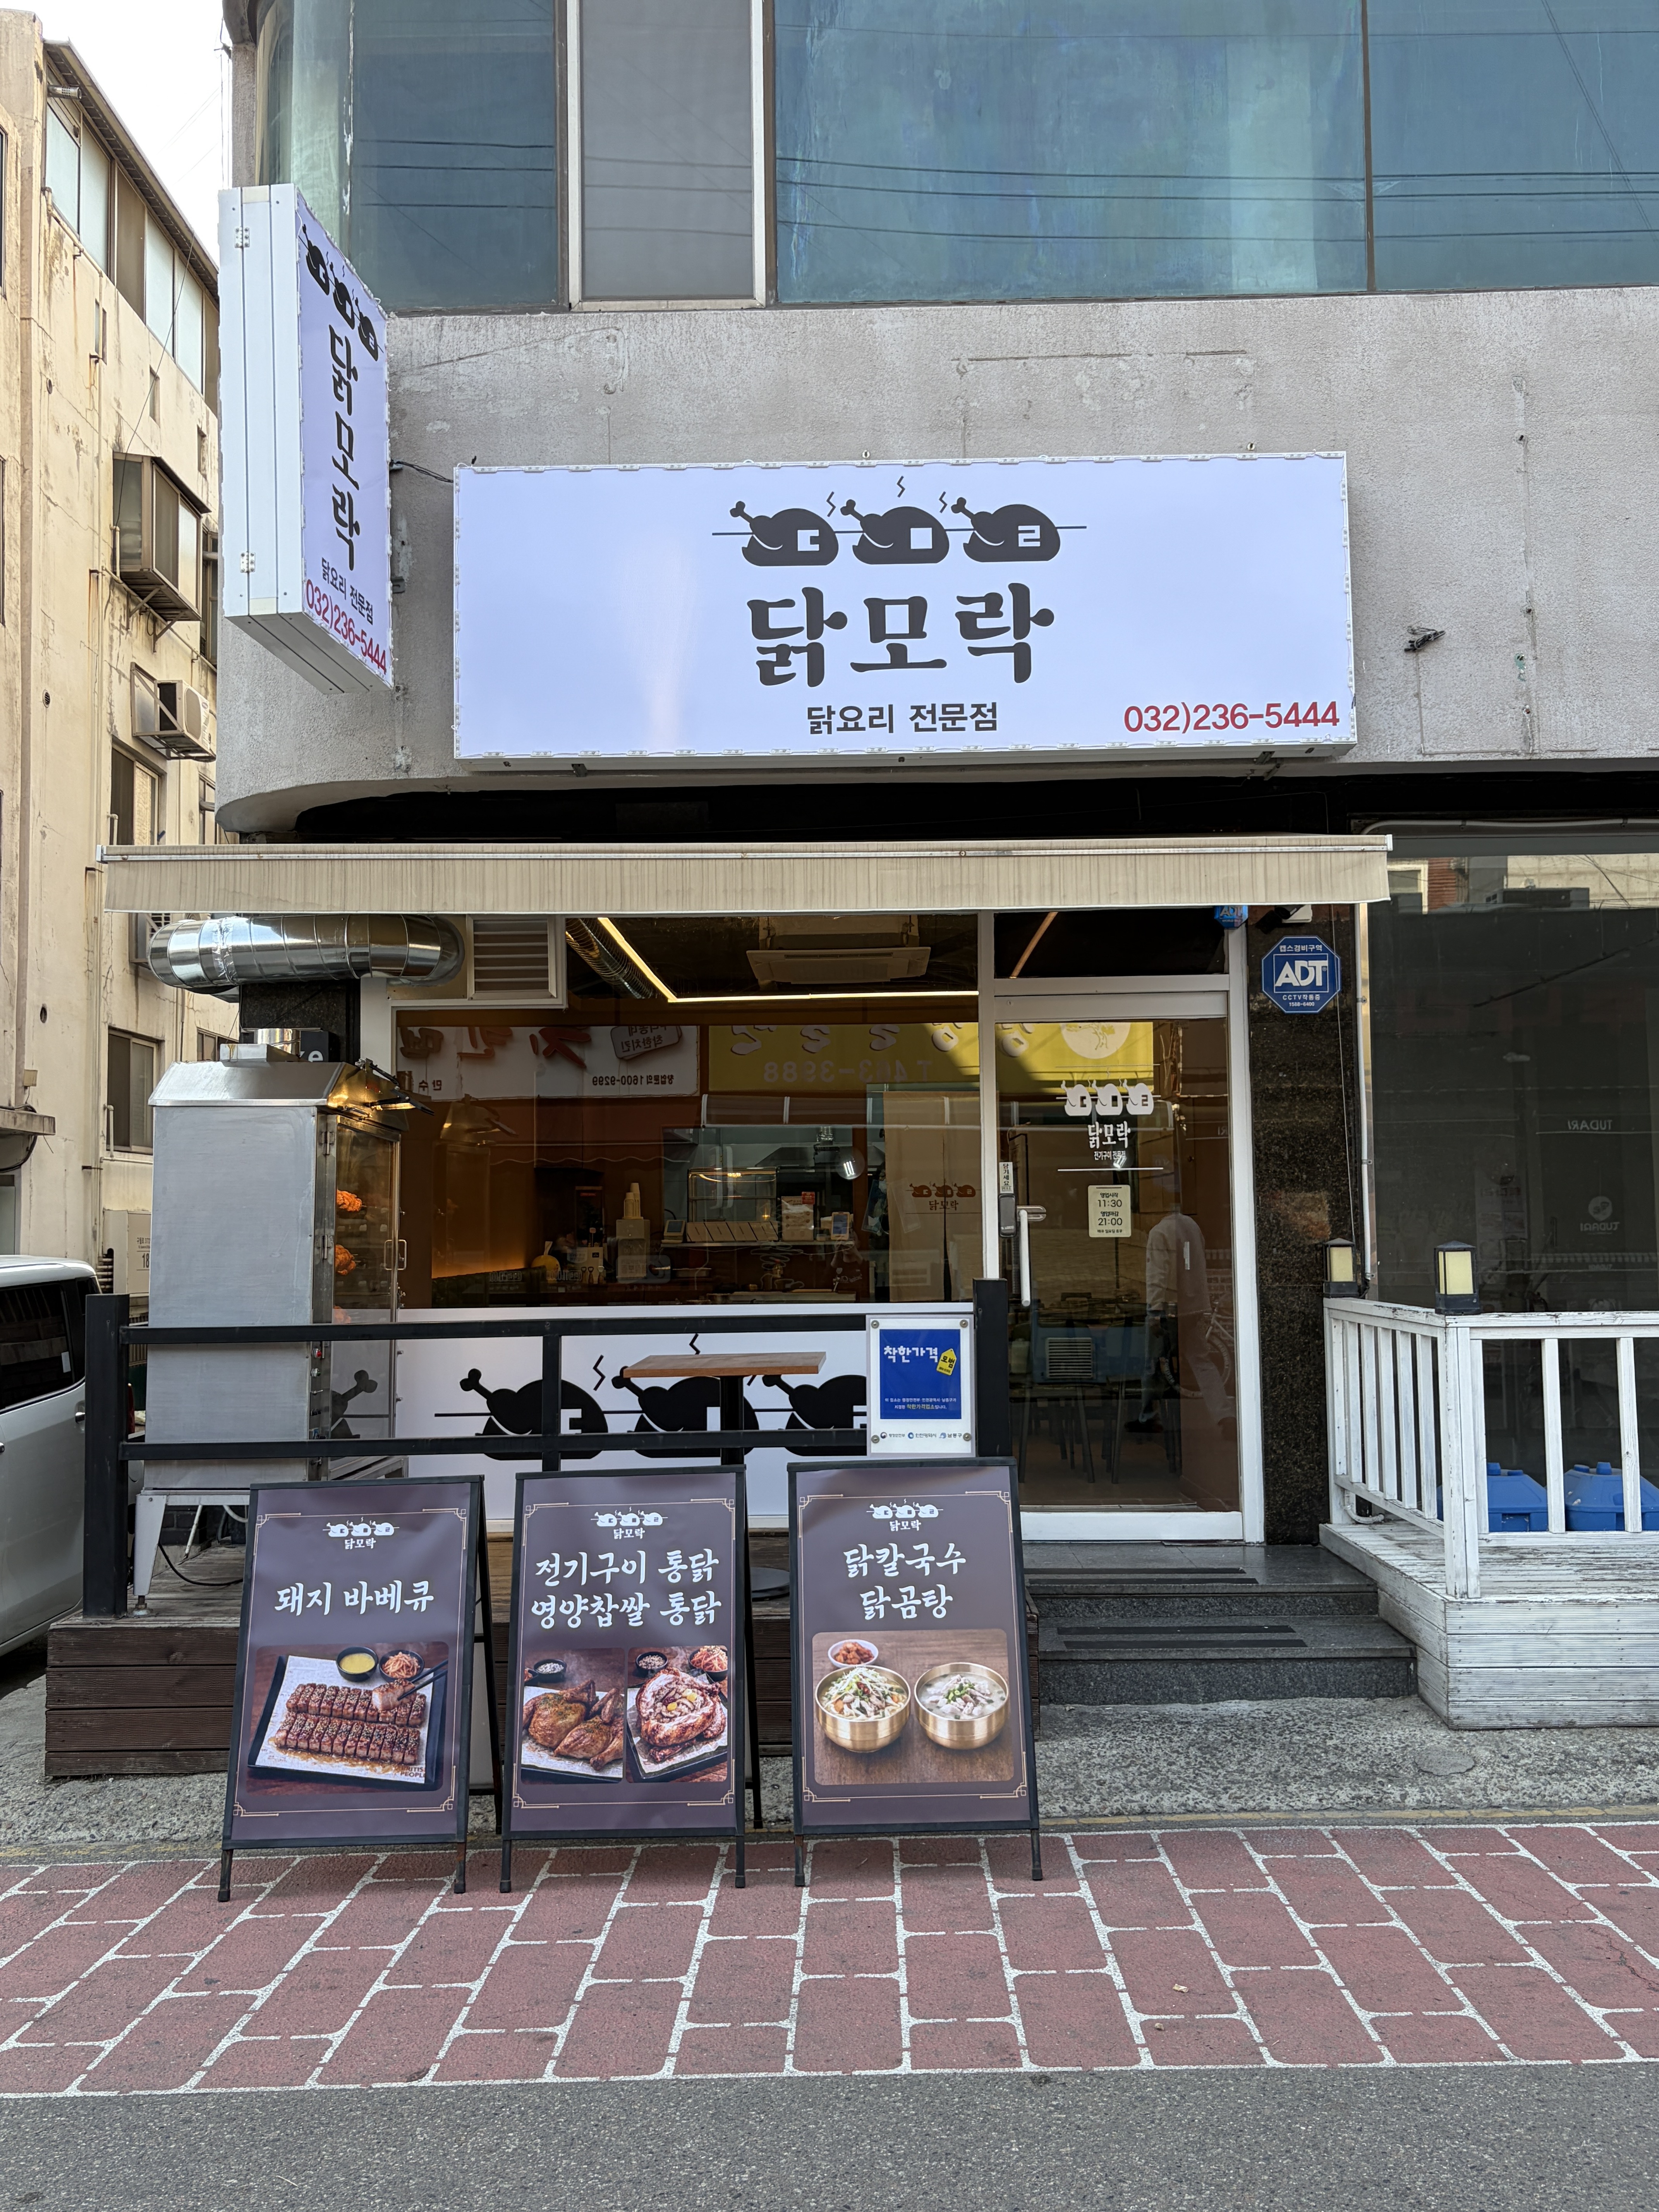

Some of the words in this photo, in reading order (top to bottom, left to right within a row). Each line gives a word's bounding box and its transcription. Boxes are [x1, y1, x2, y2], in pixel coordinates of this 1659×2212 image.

[321, 557, 347, 601] 닭요리
[349, 584, 375, 627] 전문점
[305, 579, 388, 674] 032)236-5444
[747, 583, 1054, 687] 닭모락
[807, 704, 894, 735] 닭요리
[909, 702, 998, 733] 전문점
[1124, 701, 1340, 734] 032)236-5444
[1275, 960, 1328, 987] ADT
[1088, 1121, 1131, 1149] 닭모락
[1094, 1151, 1112, 1161] 전기구이
[929, 1200, 959, 1211] 닭모락
[1098, 1199, 1122, 1207] 11:30
[1098, 1218, 1123, 1226] 21:00
[884, 1345, 938, 1363] 착한가격
[613, 1527, 645, 1540] 닭모락
[889, 1519, 922, 1532] 닭모락
[345, 1537, 376, 1550] 닭모락
[535, 1550, 646, 1587] 전기구이
[658, 1548, 720, 1583] 통닭
[843, 1543, 967, 1578] 닭칼국수
[275, 1582, 332, 1616] 돼지
[343, 1580, 434, 1615] 바베큐
[531, 1592, 651, 1630] 영양찹쌀
[659, 1590, 722, 1626] 통닭
[860, 1584, 953, 1620] 닭곰탕
